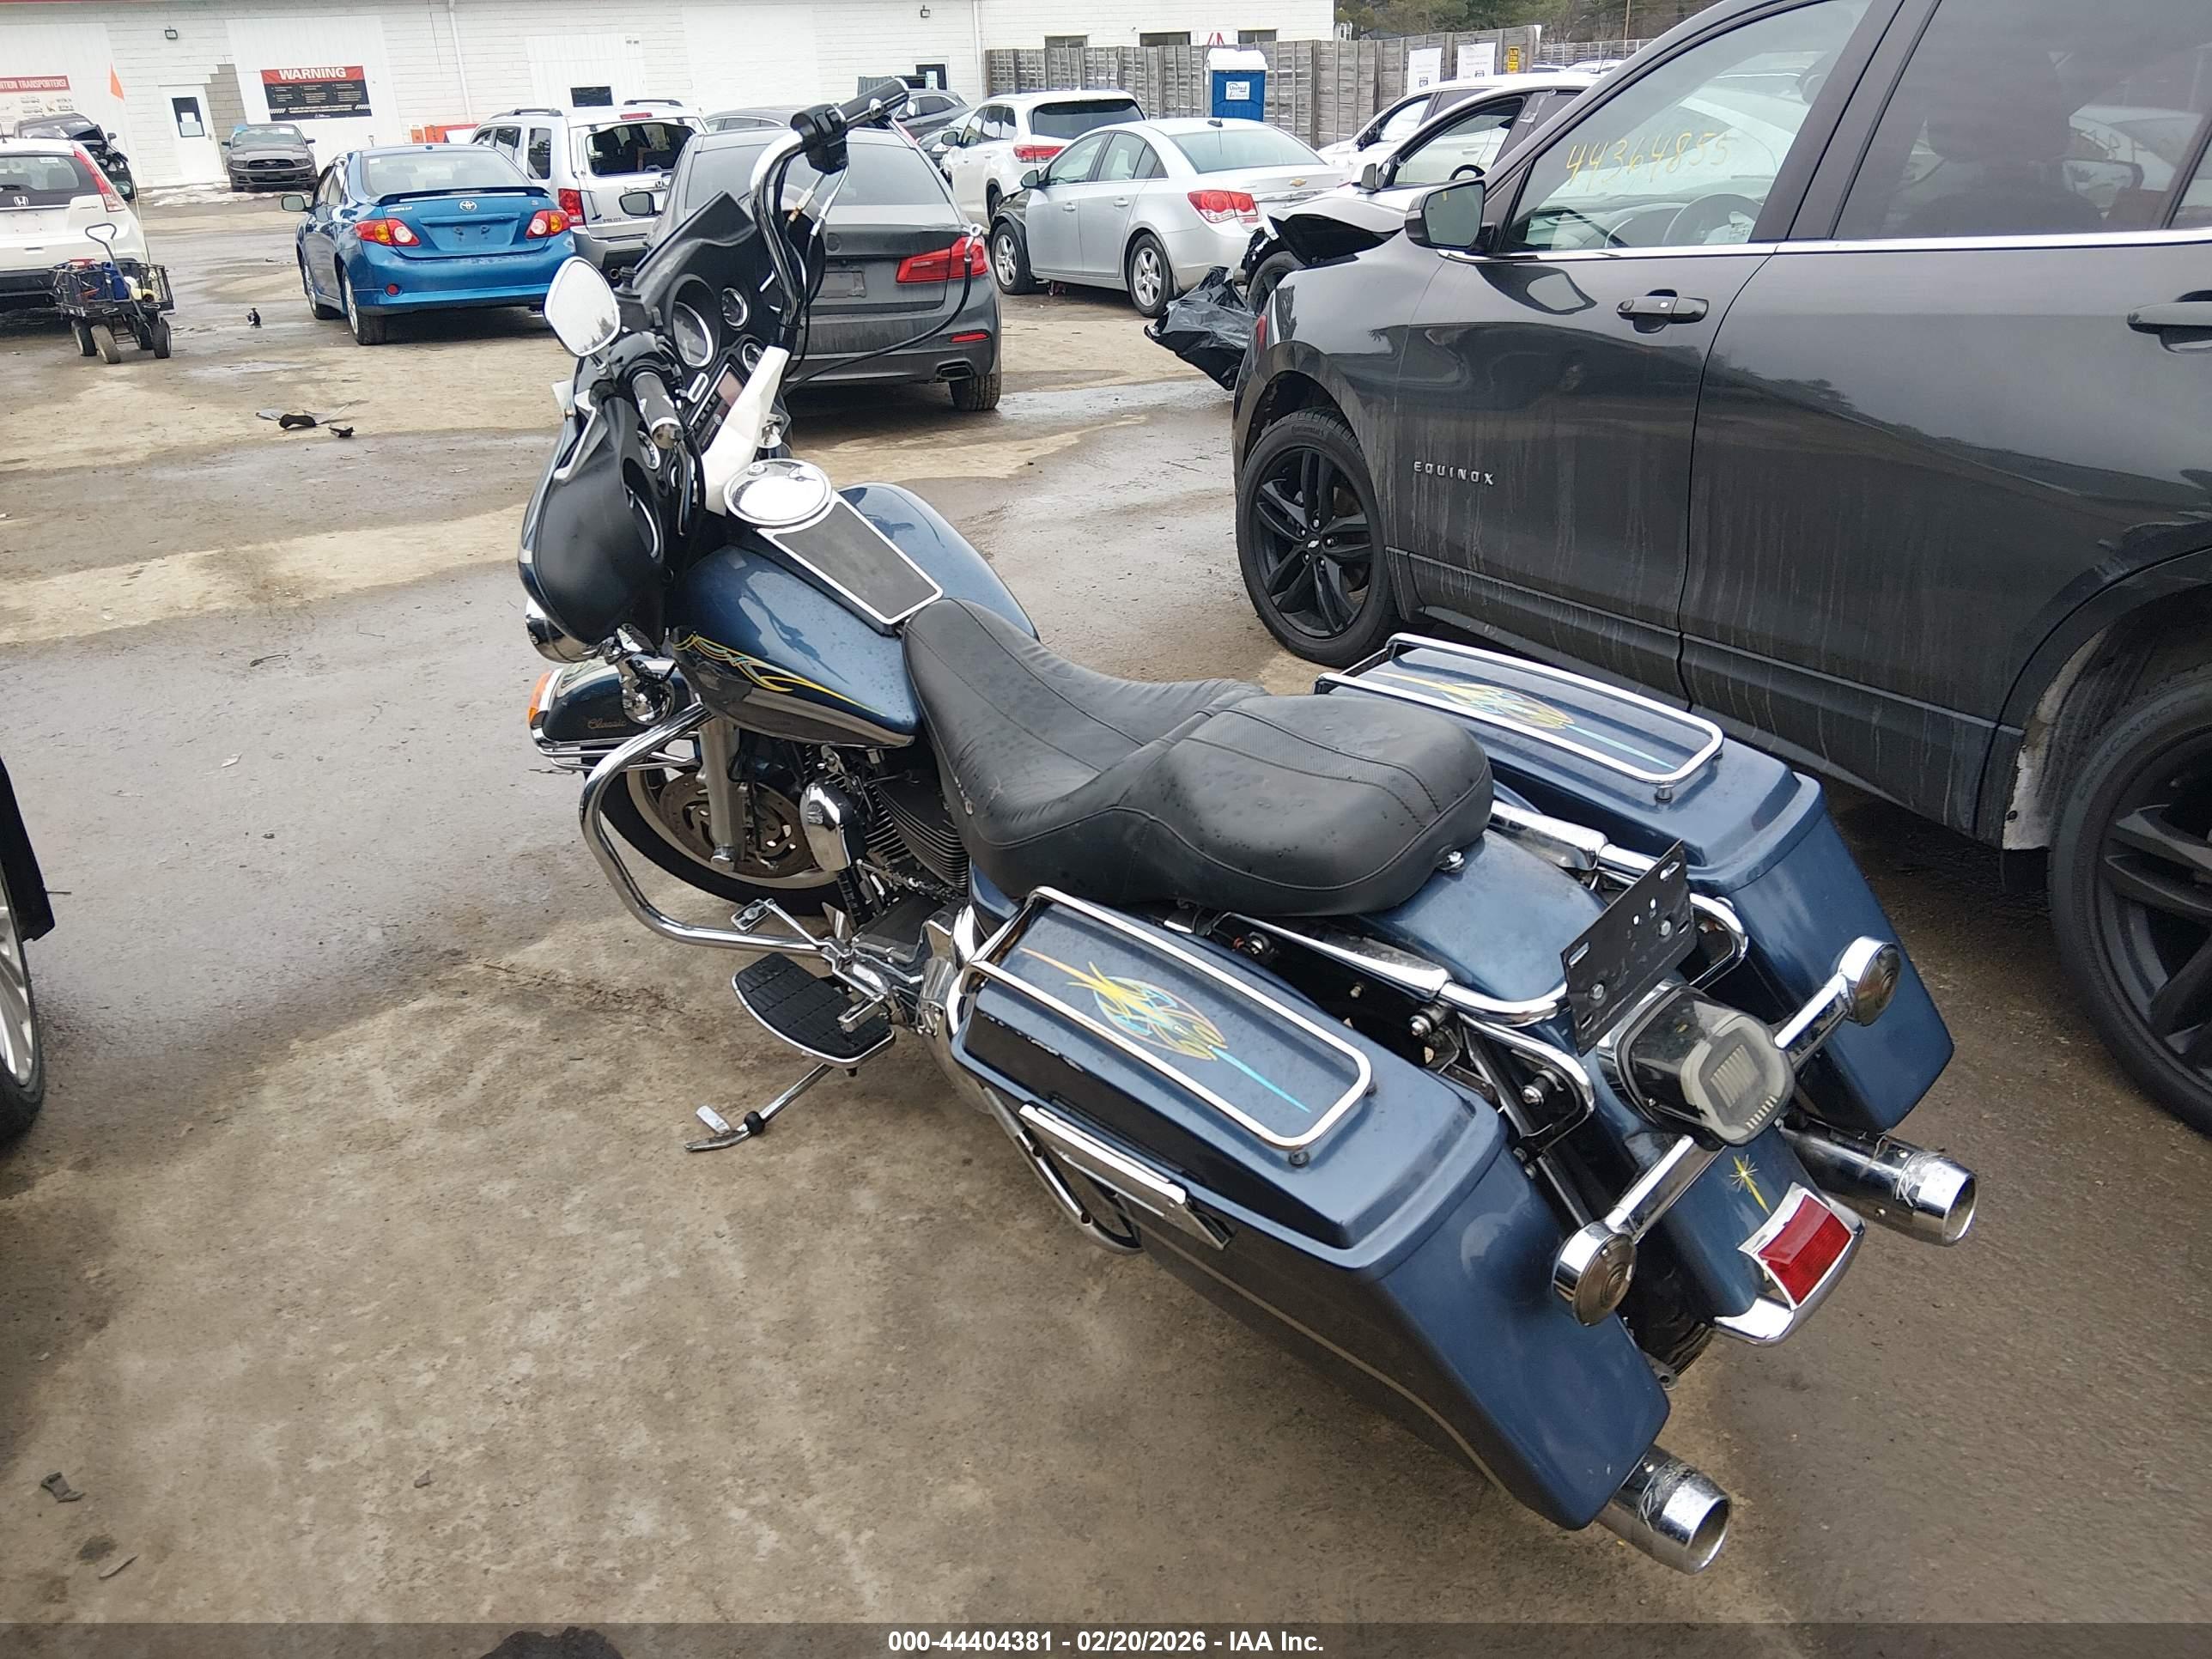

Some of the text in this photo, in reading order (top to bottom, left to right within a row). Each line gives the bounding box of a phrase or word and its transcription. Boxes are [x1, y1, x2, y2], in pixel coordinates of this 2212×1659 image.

[278, 67, 347, 80] WARNING
[1566, 132, 1738, 191] 44364855
[1413, 461, 1494, 485] EQUINOX
[587, 718, 627, 729] Classic
